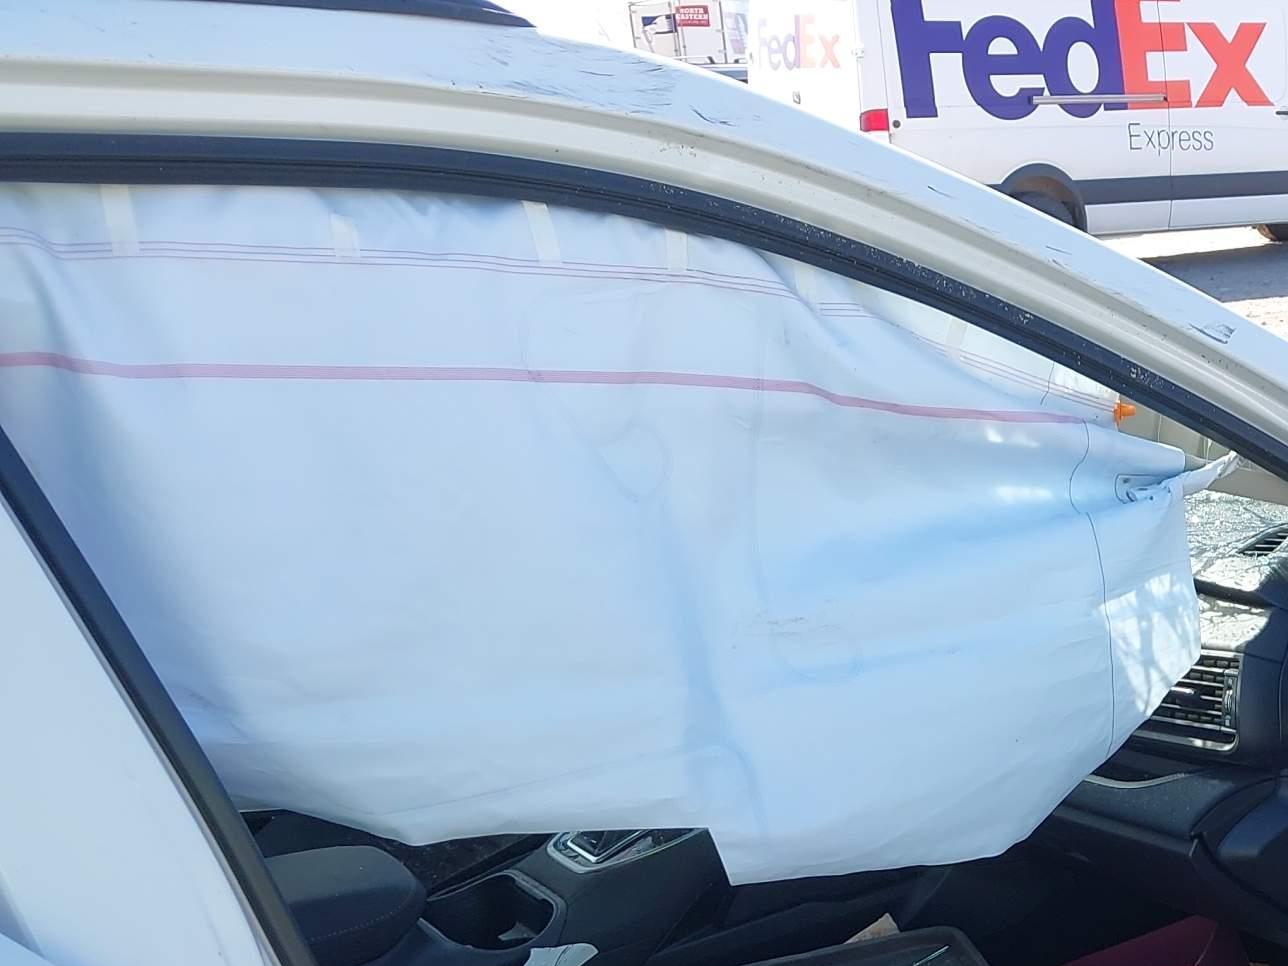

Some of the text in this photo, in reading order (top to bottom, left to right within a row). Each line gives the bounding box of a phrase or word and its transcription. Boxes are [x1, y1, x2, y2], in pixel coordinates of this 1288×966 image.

[757, 14, 841, 71] FedEx
[891, 0, 1275, 120] FedEx
[1127, 122, 1215, 156] Express
